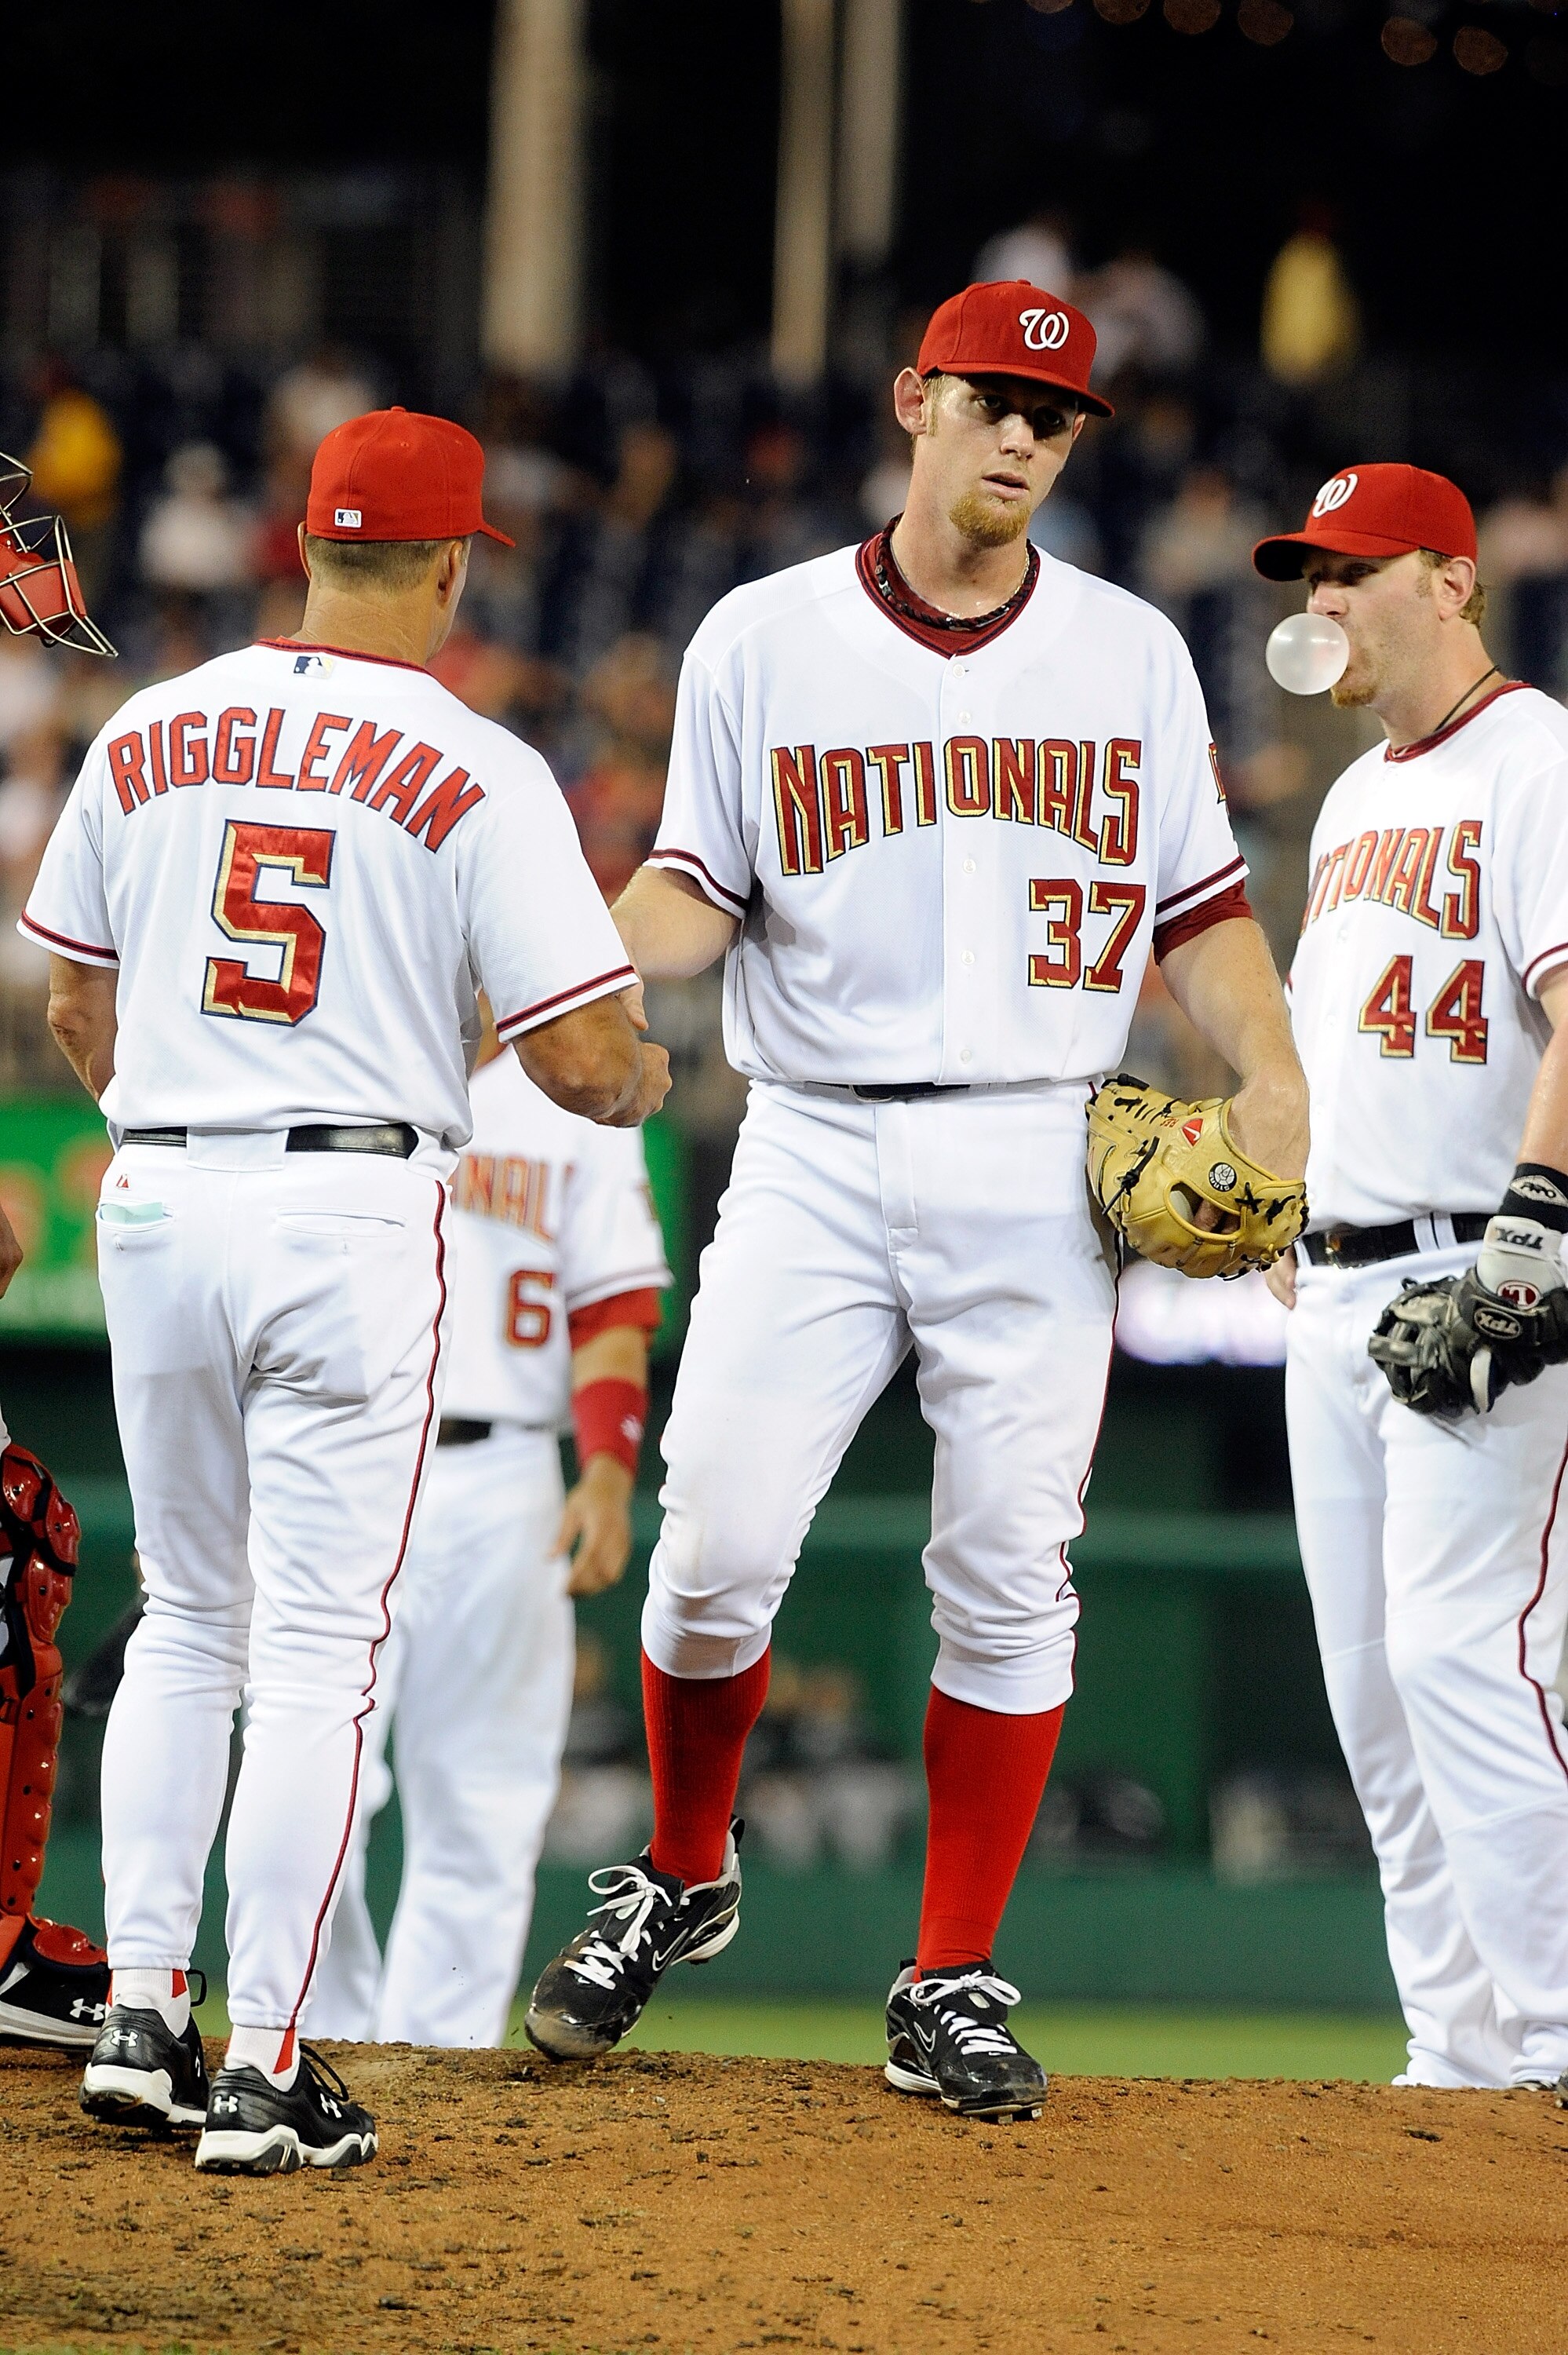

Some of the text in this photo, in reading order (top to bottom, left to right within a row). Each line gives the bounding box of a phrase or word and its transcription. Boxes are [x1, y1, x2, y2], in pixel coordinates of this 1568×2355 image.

[1019, 308, 1070, 351] W
[1311, 473, 1358, 518] W
[107, 706, 487, 853] RIGGLEMAN
[770, 736, 1142, 876] NATIONALS
[201, 819, 337, 1028] 5
[1027, 878, 1147, 994] 37
[1357, 955, 1489, 1065] 44
[1495, 1228, 1544, 1251] TPX
[507, 1269, 556, 1349] 6
[1478, 1312, 1519, 1335] TPX
